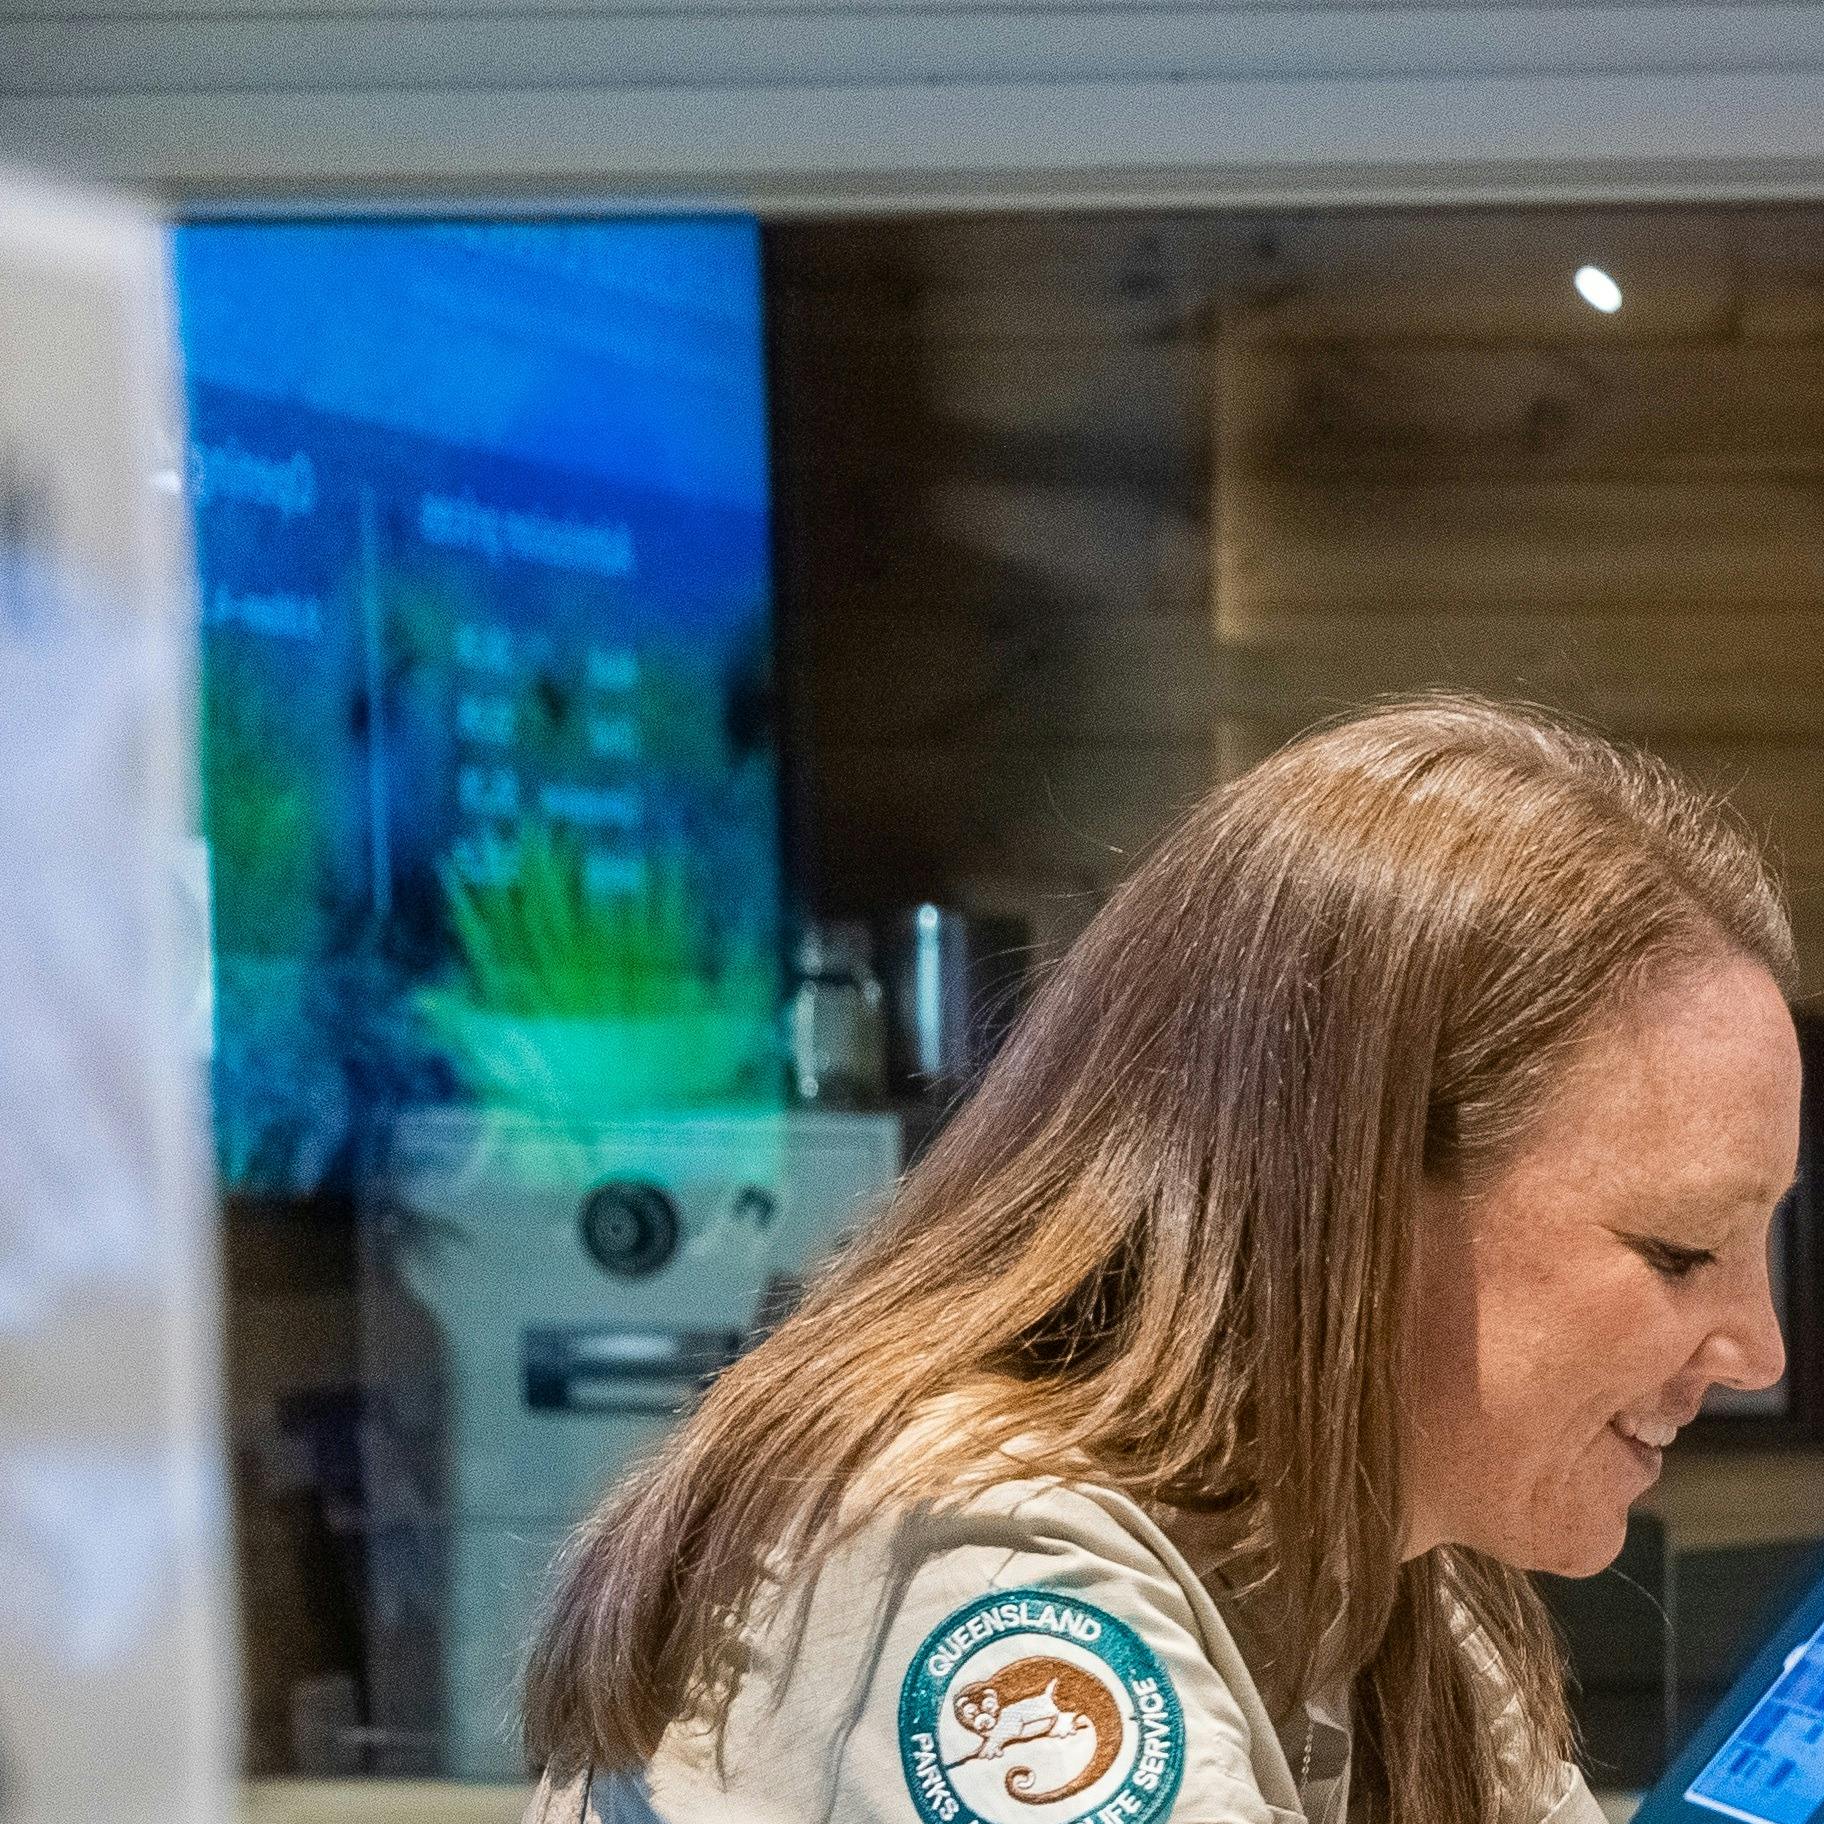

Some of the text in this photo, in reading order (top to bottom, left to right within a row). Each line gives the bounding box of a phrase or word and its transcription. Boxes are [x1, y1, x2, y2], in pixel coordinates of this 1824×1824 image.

[928, 1603, 1102, 1679] QUEENSLAND
[910, 1732, 960, 1822] PARKS
[1132, 1678, 1171, 1791] SERVICE
